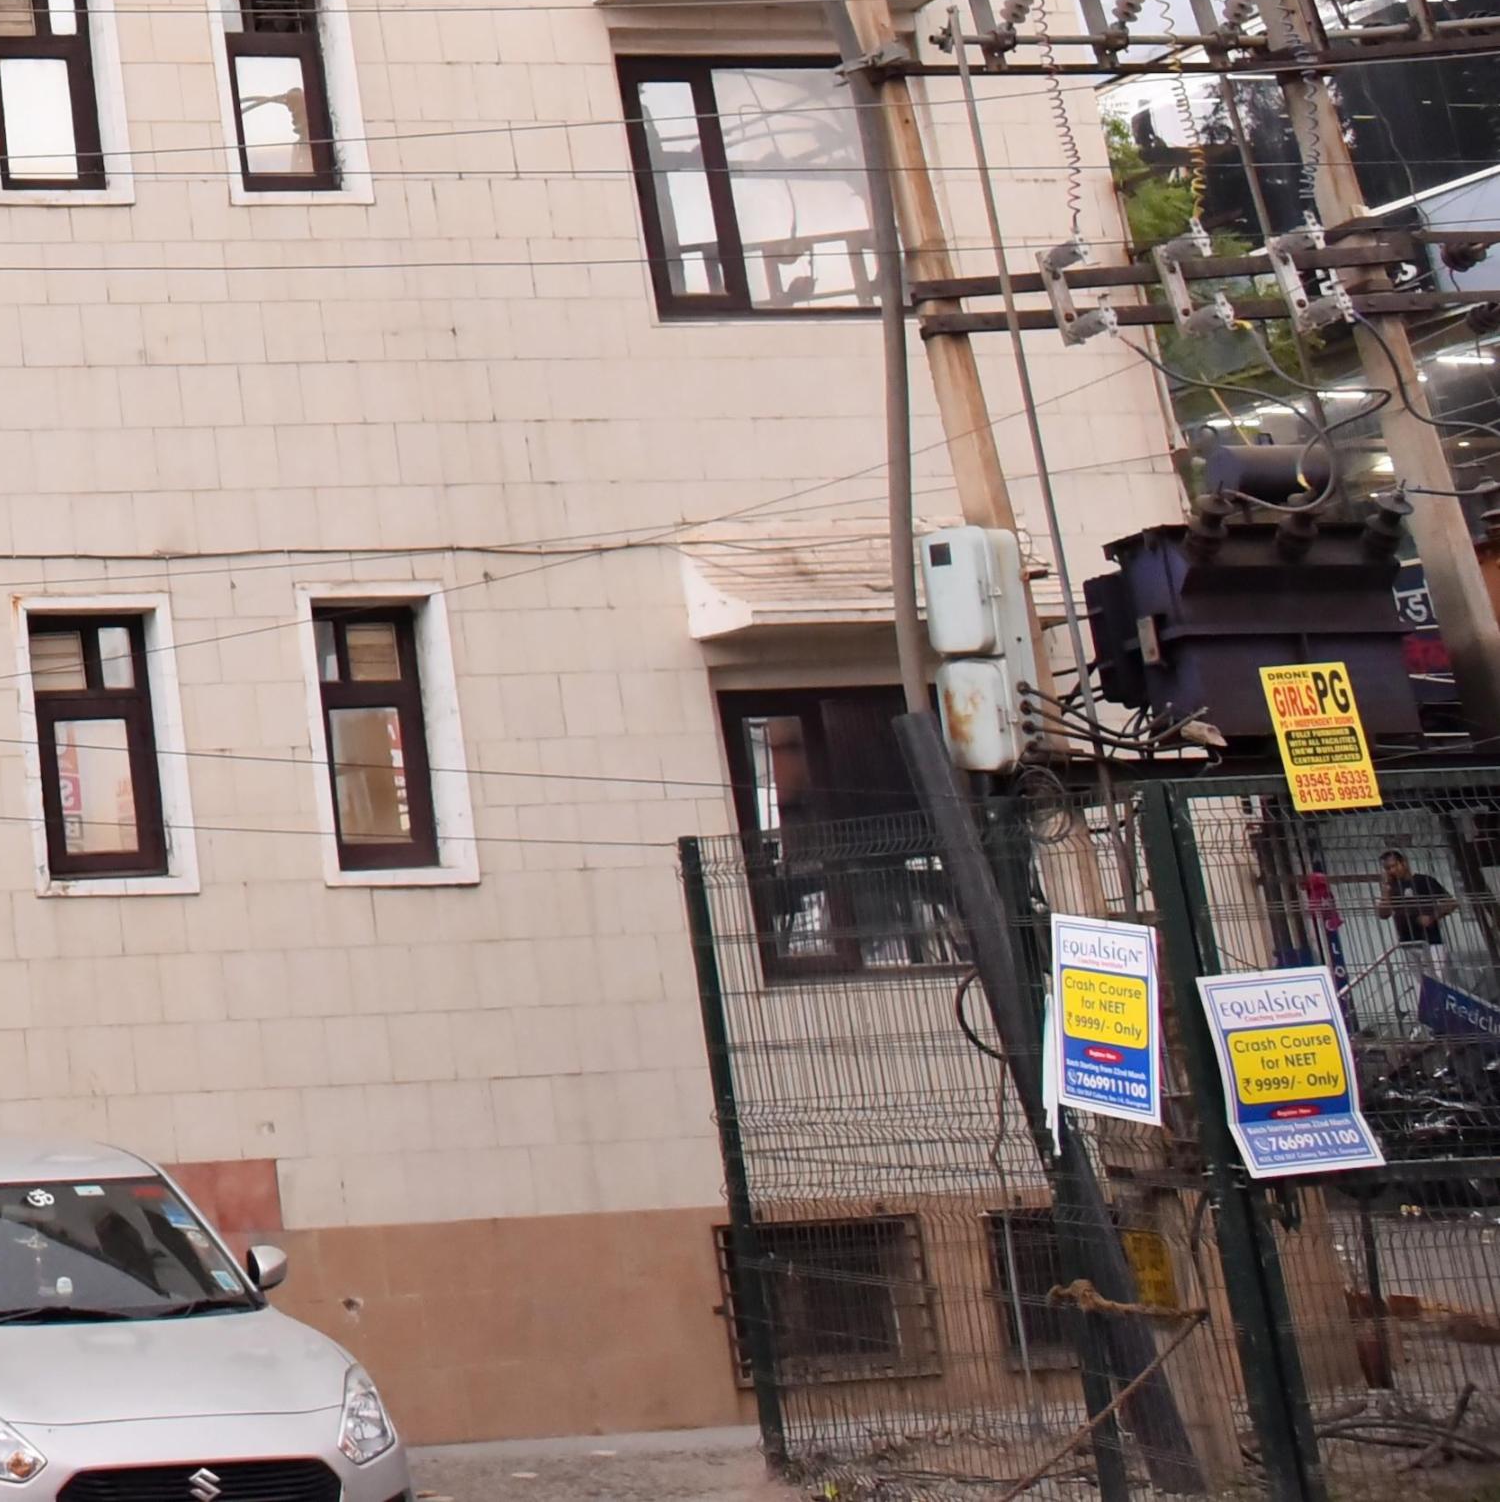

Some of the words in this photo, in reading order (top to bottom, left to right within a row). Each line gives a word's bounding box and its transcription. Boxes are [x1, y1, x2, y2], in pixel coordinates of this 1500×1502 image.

[1267, 670, 1310, 681] DRONE
[1311, 669, 1351, 715] PG
[1273, 684, 1319, 719] GIRLS
[1295, 772, 1331, 788] 93545
[1335, 769, 1370, 785] 45335
[1299, 788, 1336, 803] 81305
[1338, 785, 1374, 800] 99932
[1064, 976, 1096, 992] Crash
[1099, 981, 1142, 999] Course
[1081, 995, 1095, 1010] for
[1099, 998, 1126, 1015] NEET
[1114, 1021, 1142, 1040] Only
[1234, 1037, 1277, 1053] Crash
[1280, 1034, 1332, 1049] Course
[1261, 1055, 1280, 1070] for
[1284, 1052, 1317, 1067] NEET
[1075, 1072, 1147, 1099] 7669911100
[1306, 1071, 1340, 1088] Only
[1268, 1129, 1360, 1151] 7669911100
